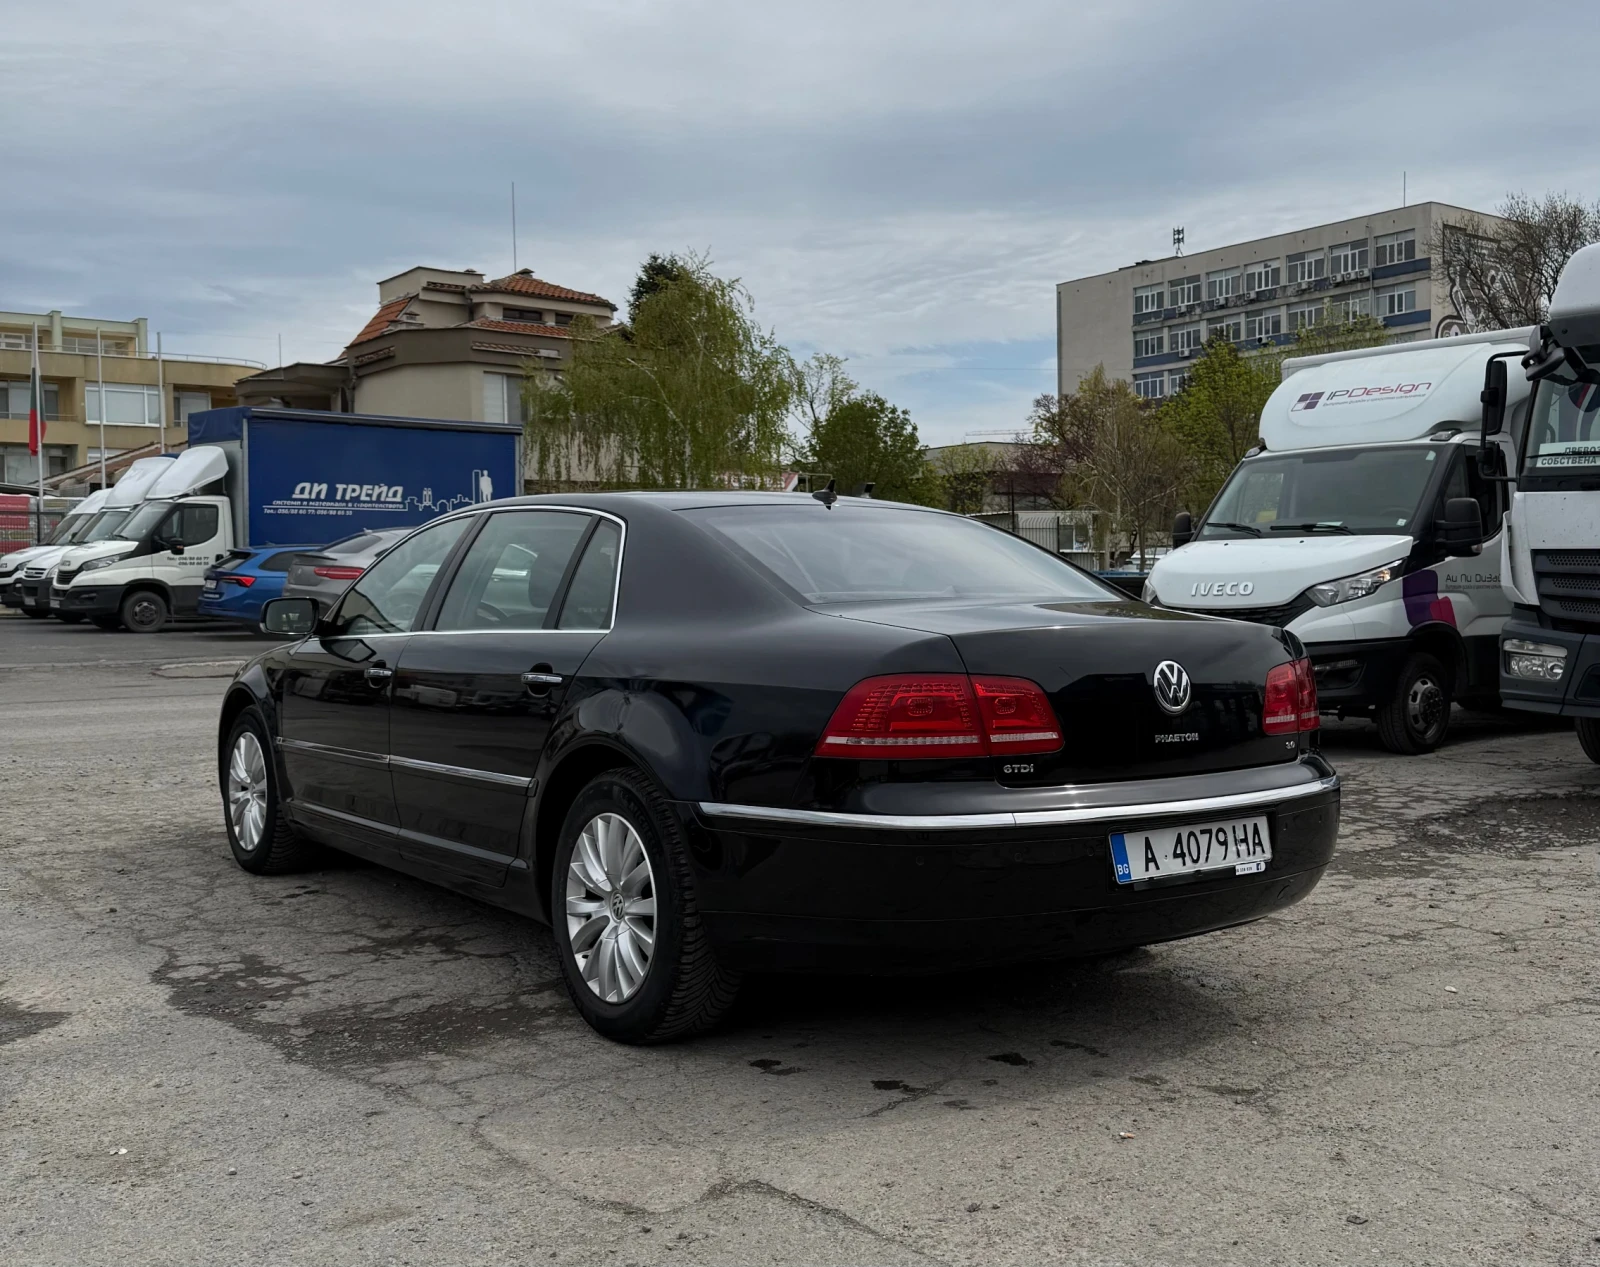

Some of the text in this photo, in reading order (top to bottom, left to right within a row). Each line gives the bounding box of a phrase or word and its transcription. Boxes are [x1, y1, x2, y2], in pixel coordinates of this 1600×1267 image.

[1541, 456, 1597, 466] СОБСТВЕНА
[291, 482, 404, 502] ДИ ТРЕЙД
[1191, 581, 1255, 597] IVECO
[1154, 733, 1199, 743] PHAETON
[1117, 863, 1129, 875] BG
